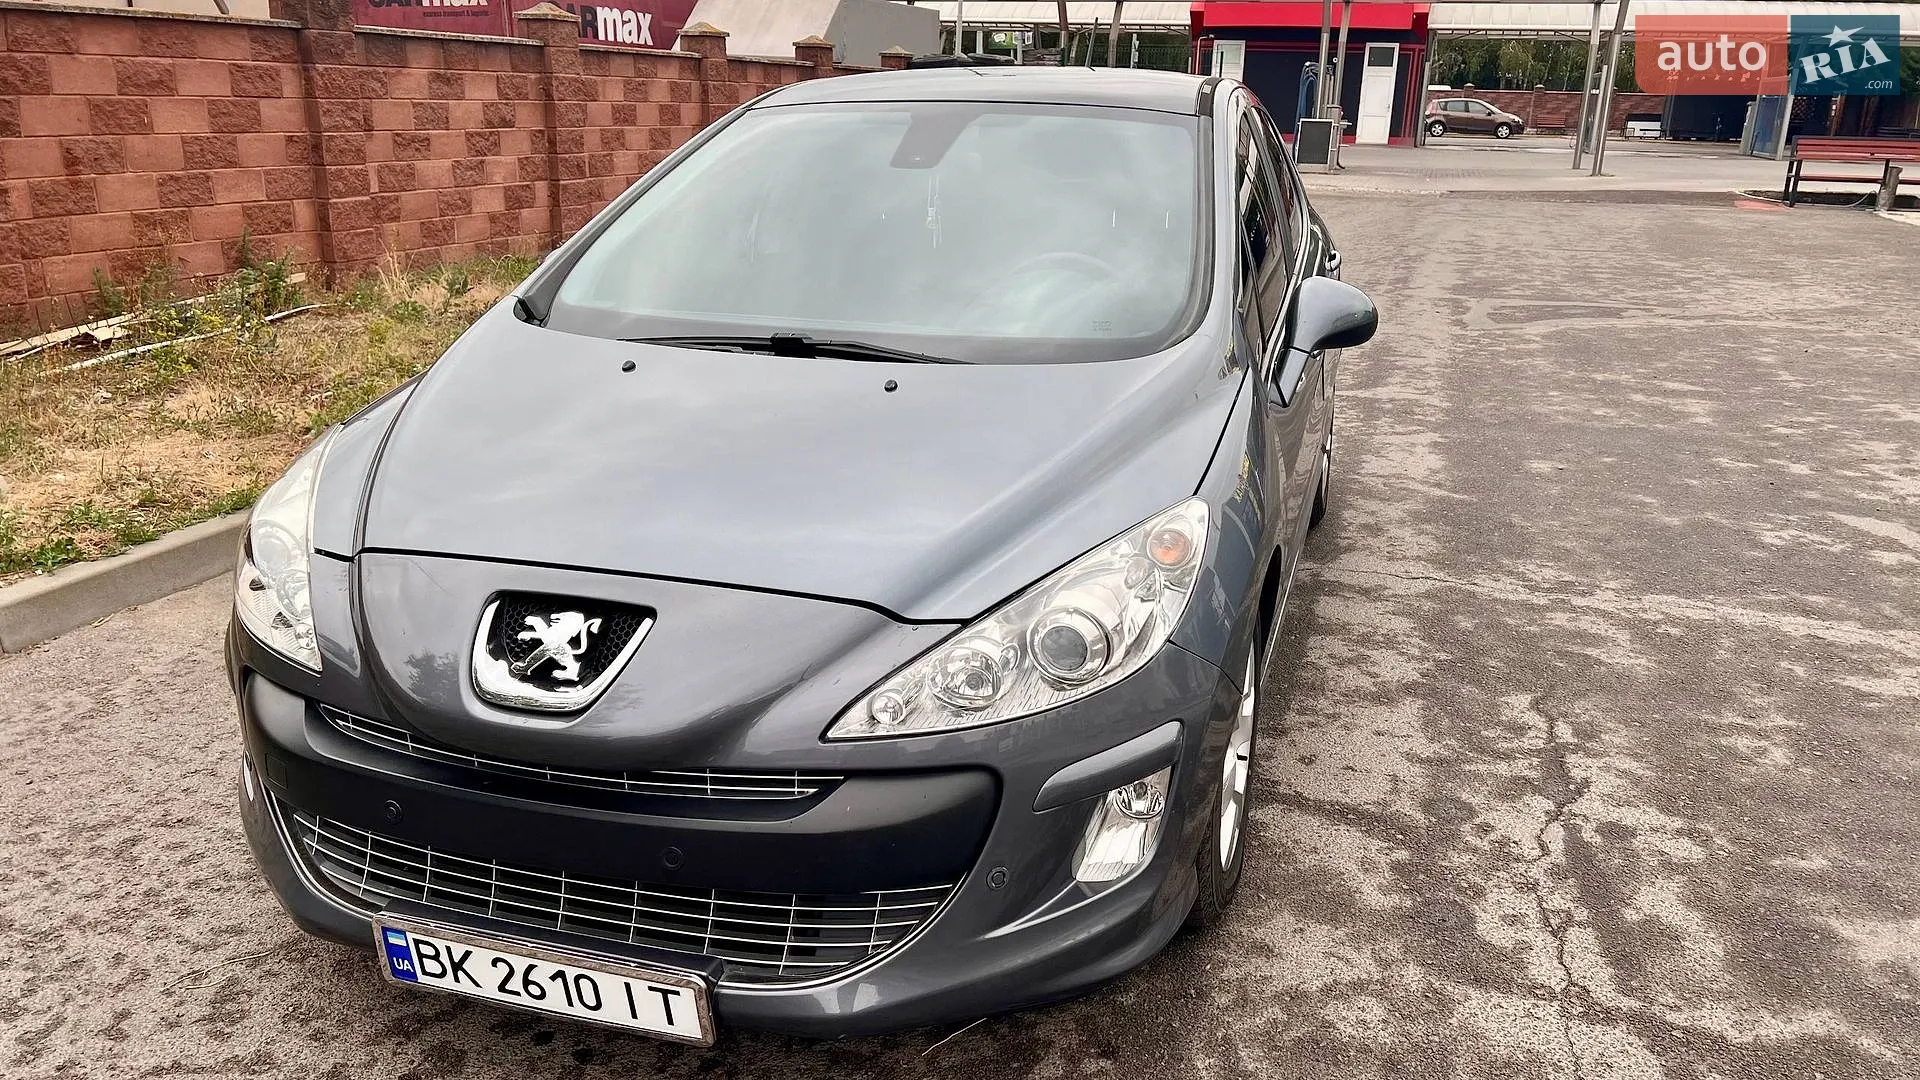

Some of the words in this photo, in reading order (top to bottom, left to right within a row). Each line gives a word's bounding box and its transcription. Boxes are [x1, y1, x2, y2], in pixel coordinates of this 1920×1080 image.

[550, 0, 653, 45] Rmax
[393, 956, 414, 972] UA
[412, 938, 483, 989] BK
[491, 957, 602, 1011] 2610
